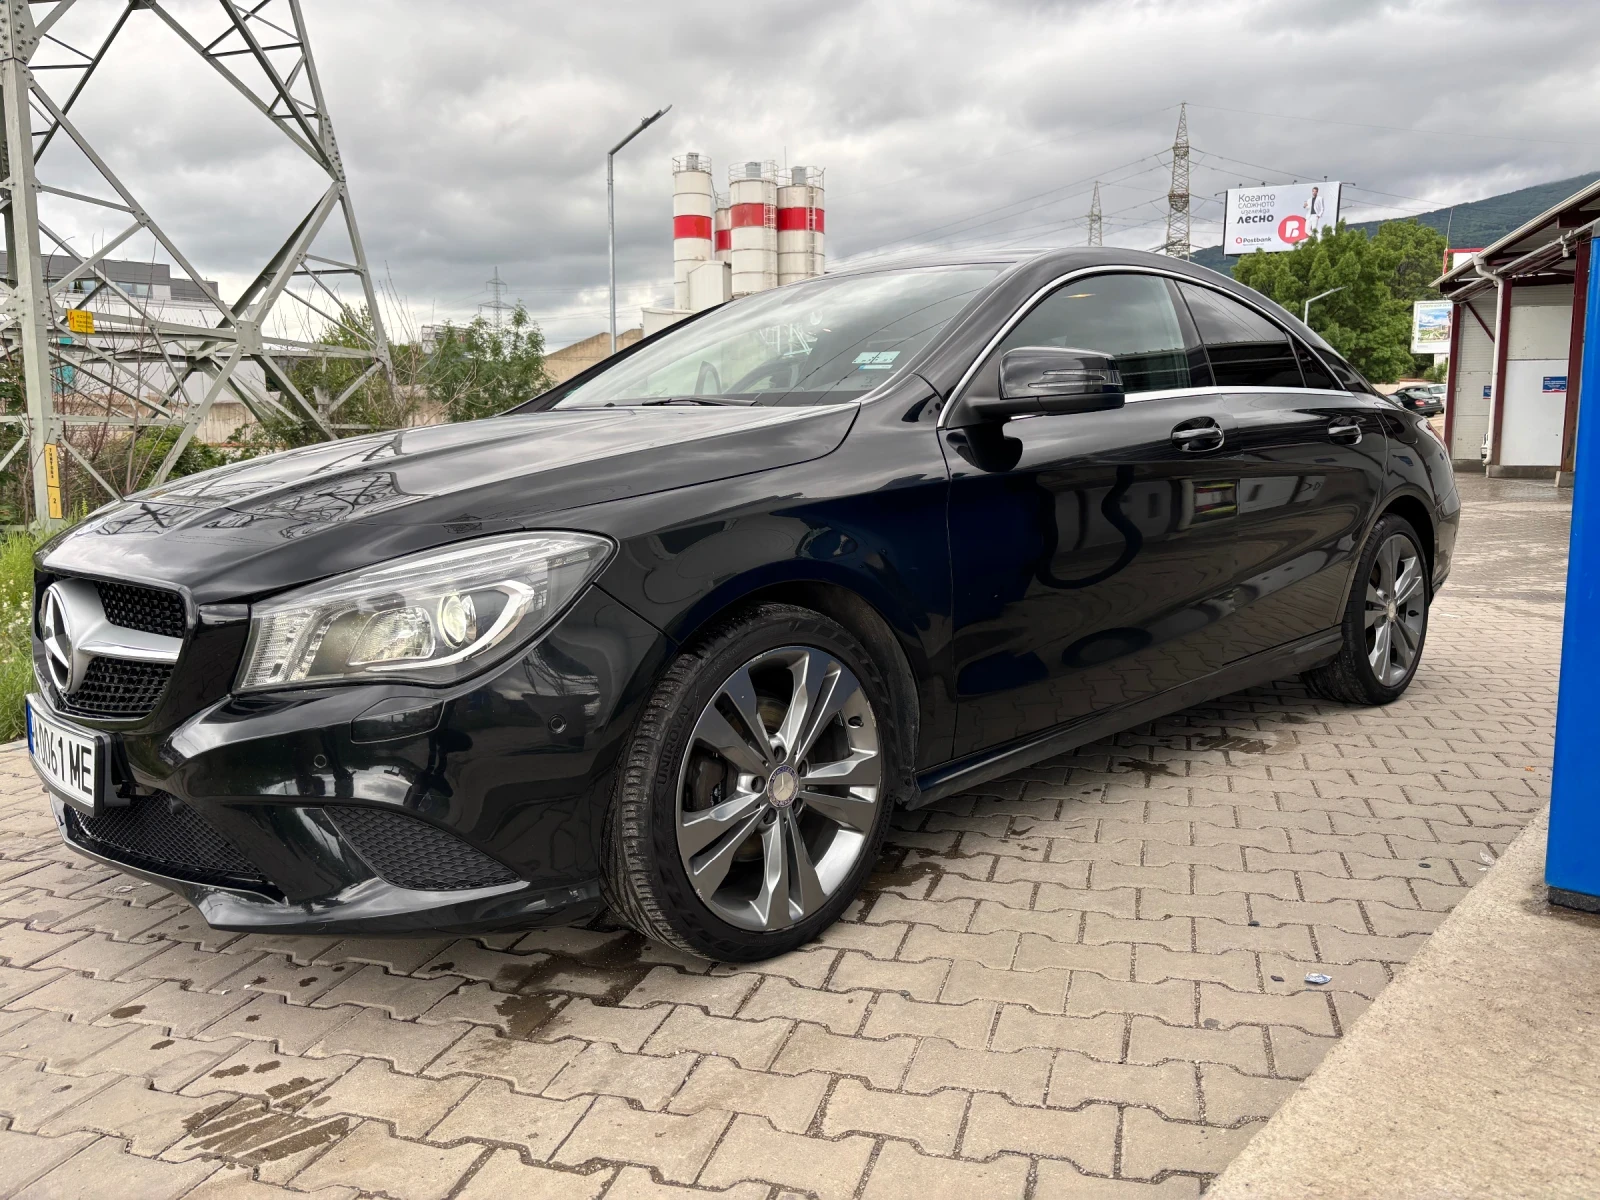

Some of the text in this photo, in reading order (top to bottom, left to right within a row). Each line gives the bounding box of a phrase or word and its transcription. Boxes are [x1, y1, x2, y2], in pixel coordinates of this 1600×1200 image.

[1238, 193, 1276, 203] Когато
[69, 740, 93, 796] ME
[657, 702, 694, 785] UNIROYAL
